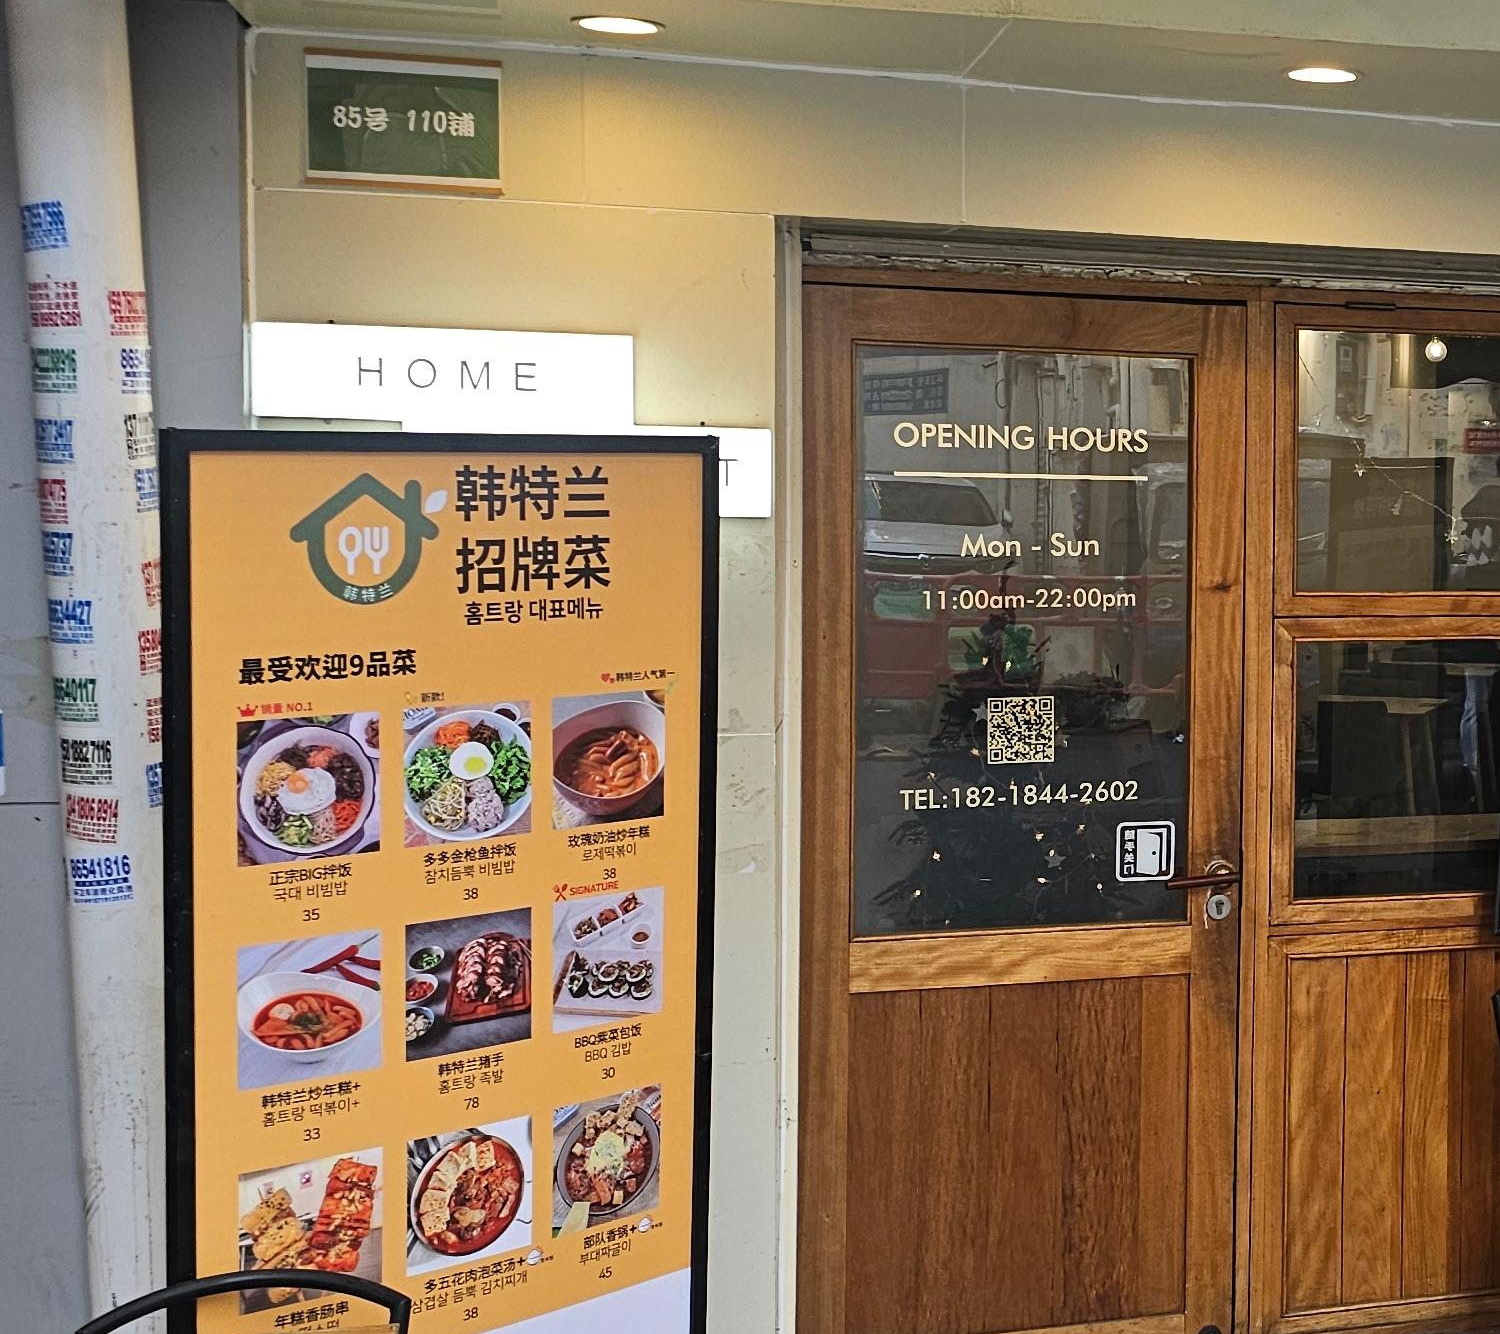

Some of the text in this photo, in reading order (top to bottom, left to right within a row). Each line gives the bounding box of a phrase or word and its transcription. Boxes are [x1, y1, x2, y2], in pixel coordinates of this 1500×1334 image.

[333, 106, 474, 137] 85号 110铺
[357, 358, 537, 393] HOME
[893, 421, 1149, 453] OPENING HOURS
[455, 465, 610, 521] 韩特兰
[960, 533, 1021, 557] Mon
[1050, 532, 1099, 557] Sun
[455, 534, 611, 594] 招牌菜
[343, 582, 394, 602] 韩特兰
[922, 588, 1136, 612] 11:00am-22:00pm
[464, 597, 604, 626] 홈트랑 대표메뉴
[239, 649, 416, 685] 最受欢迎9品菜
[287, 702, 313, 712] NO.1
[900, 780, 1139, 811] TEL:182-1844-2602
[568, 826, 651, 848] 玫瑰奶油炒年糕
[424, 843, 517, 867] 多多金枪鱼拌饭
[582, 842, 637, 862] 로제떡볶이
[269, 862, 352, 885] 正宗BIG拌饭
[479, 859, 515, 876] 비빔밥
[603, 868, 617, 880] 38
[273, 880, 348, 902] 국대 비빔밥
[463, 888, 479, 900] 38
[570, 881, 619, 896] SIGNATURE
[302, 908, 320, 922] 35
[584, 1042, 632, 1062] BBQ 김밥
[438, 1052, 504, 1077] 韩特兰猪手
[601, 1067, 615, 1080] 30
[438, 1068, 504, 1094] 홈트랑 족발
[464, 1097, 480, 1110] 78
[262, 1105, 304, 1128] 홈트랑
[303, 1127, 321, 1141] 33
[599, 1266, 612, 1278] 45
[411, 1292, 448, 1314] 삼겹살
[481, 1270, 528, 1296] 김치찌개
[274, 1301, 349, 1329] 年糕香肠串
[463, 1307, 479, 1321] 38
